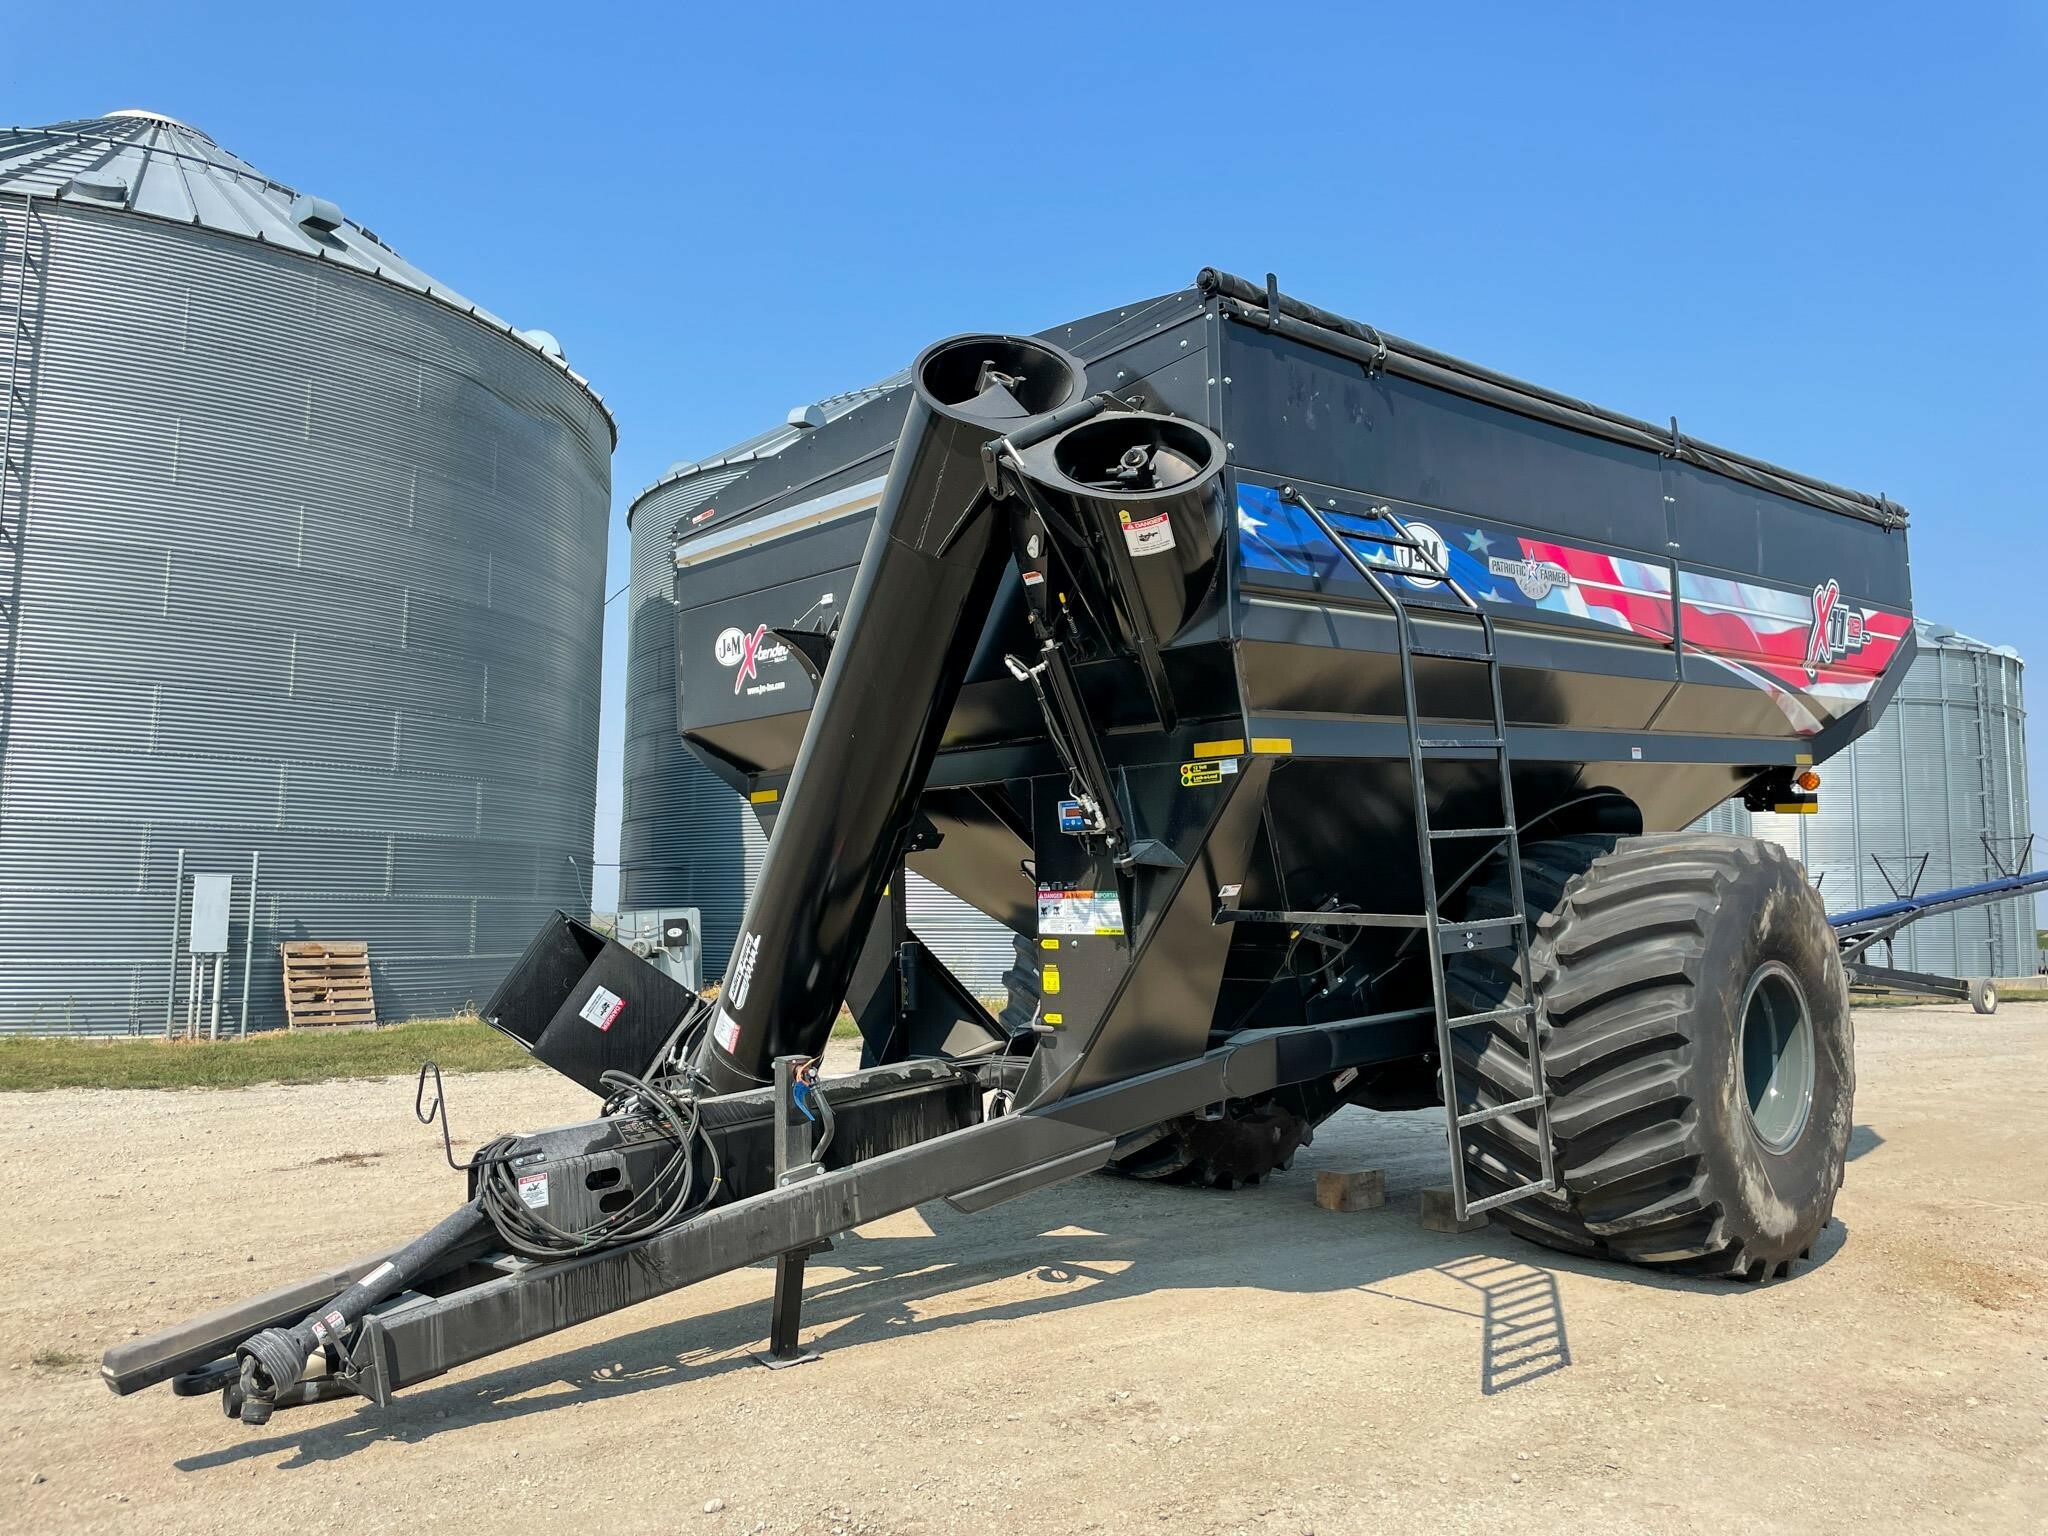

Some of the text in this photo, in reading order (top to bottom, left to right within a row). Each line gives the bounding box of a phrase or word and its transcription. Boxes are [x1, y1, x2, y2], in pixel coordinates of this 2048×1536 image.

[1135, 515, 1163, 528] DANGER
[1491, 559, 1567, 584] PATRIOTIC FARMER
[719, 635, 741, 658] J&M
